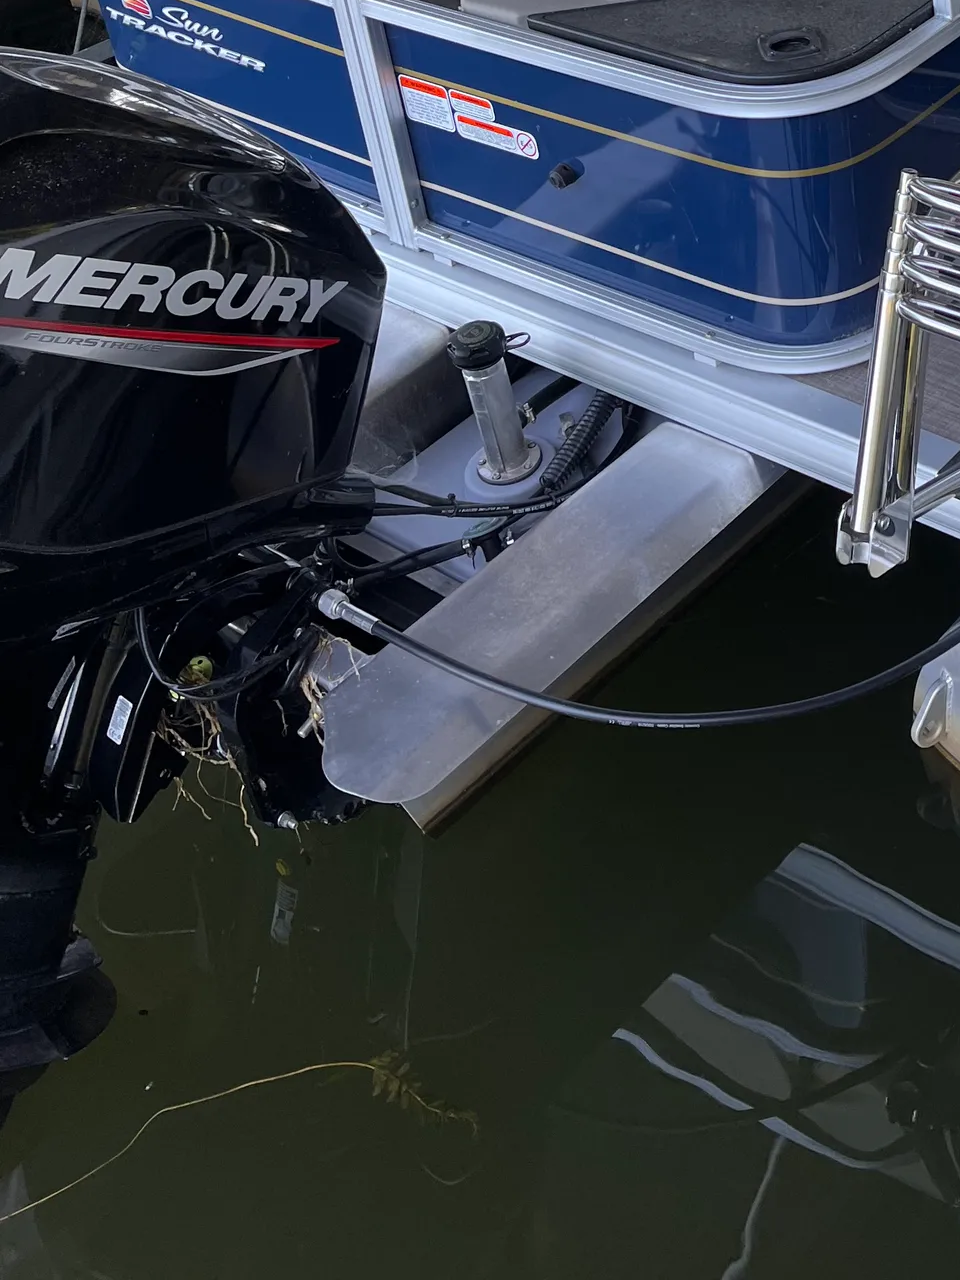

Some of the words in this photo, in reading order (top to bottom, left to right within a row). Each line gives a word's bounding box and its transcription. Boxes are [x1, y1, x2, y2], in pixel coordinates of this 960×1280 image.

[105, 6, 267, 73] TRACKER
[154, 6, 224, 42] Sun
[0, 247, 350, 324] MERCURY
